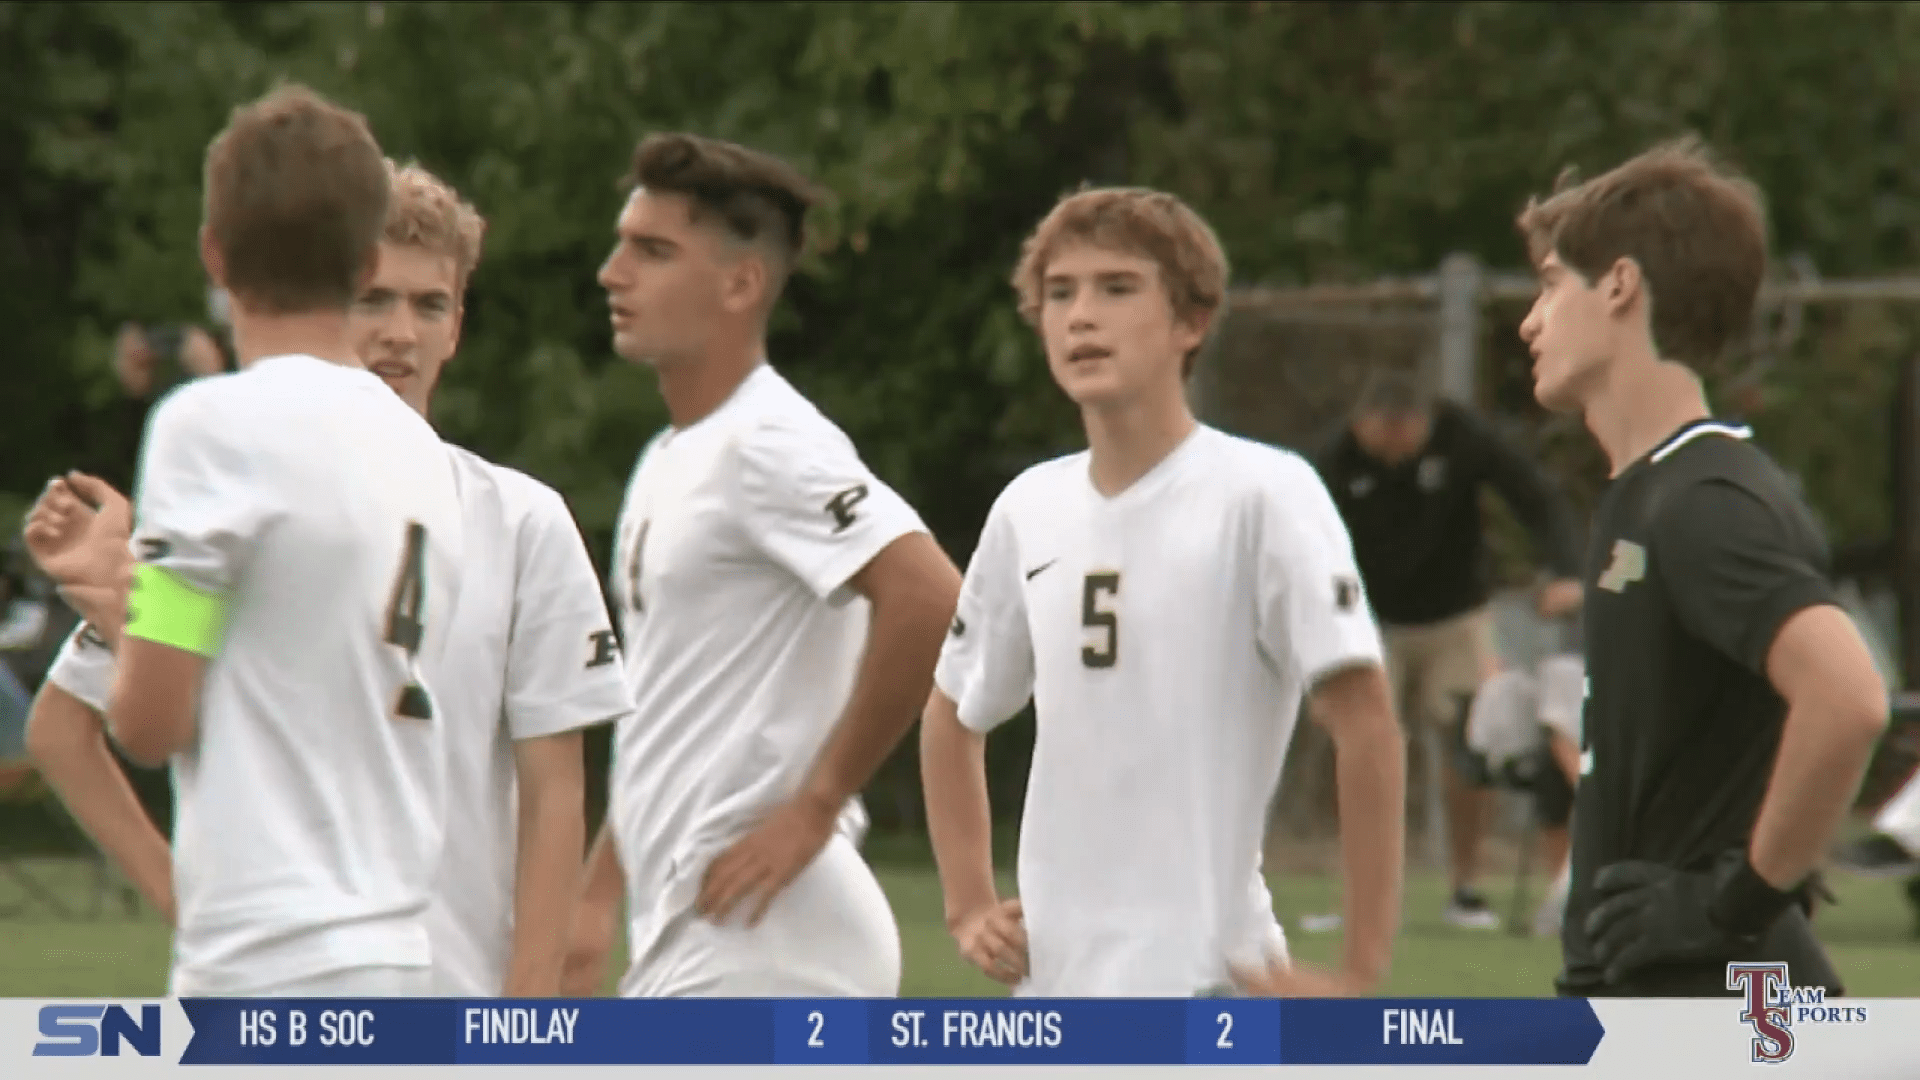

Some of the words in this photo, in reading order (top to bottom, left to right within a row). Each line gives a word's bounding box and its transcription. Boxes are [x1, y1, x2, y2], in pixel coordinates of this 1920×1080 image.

[825, 484, 869, 533] P
[384, 521, 432, 720] 4
[1081, 573, 1120, 668] 5
